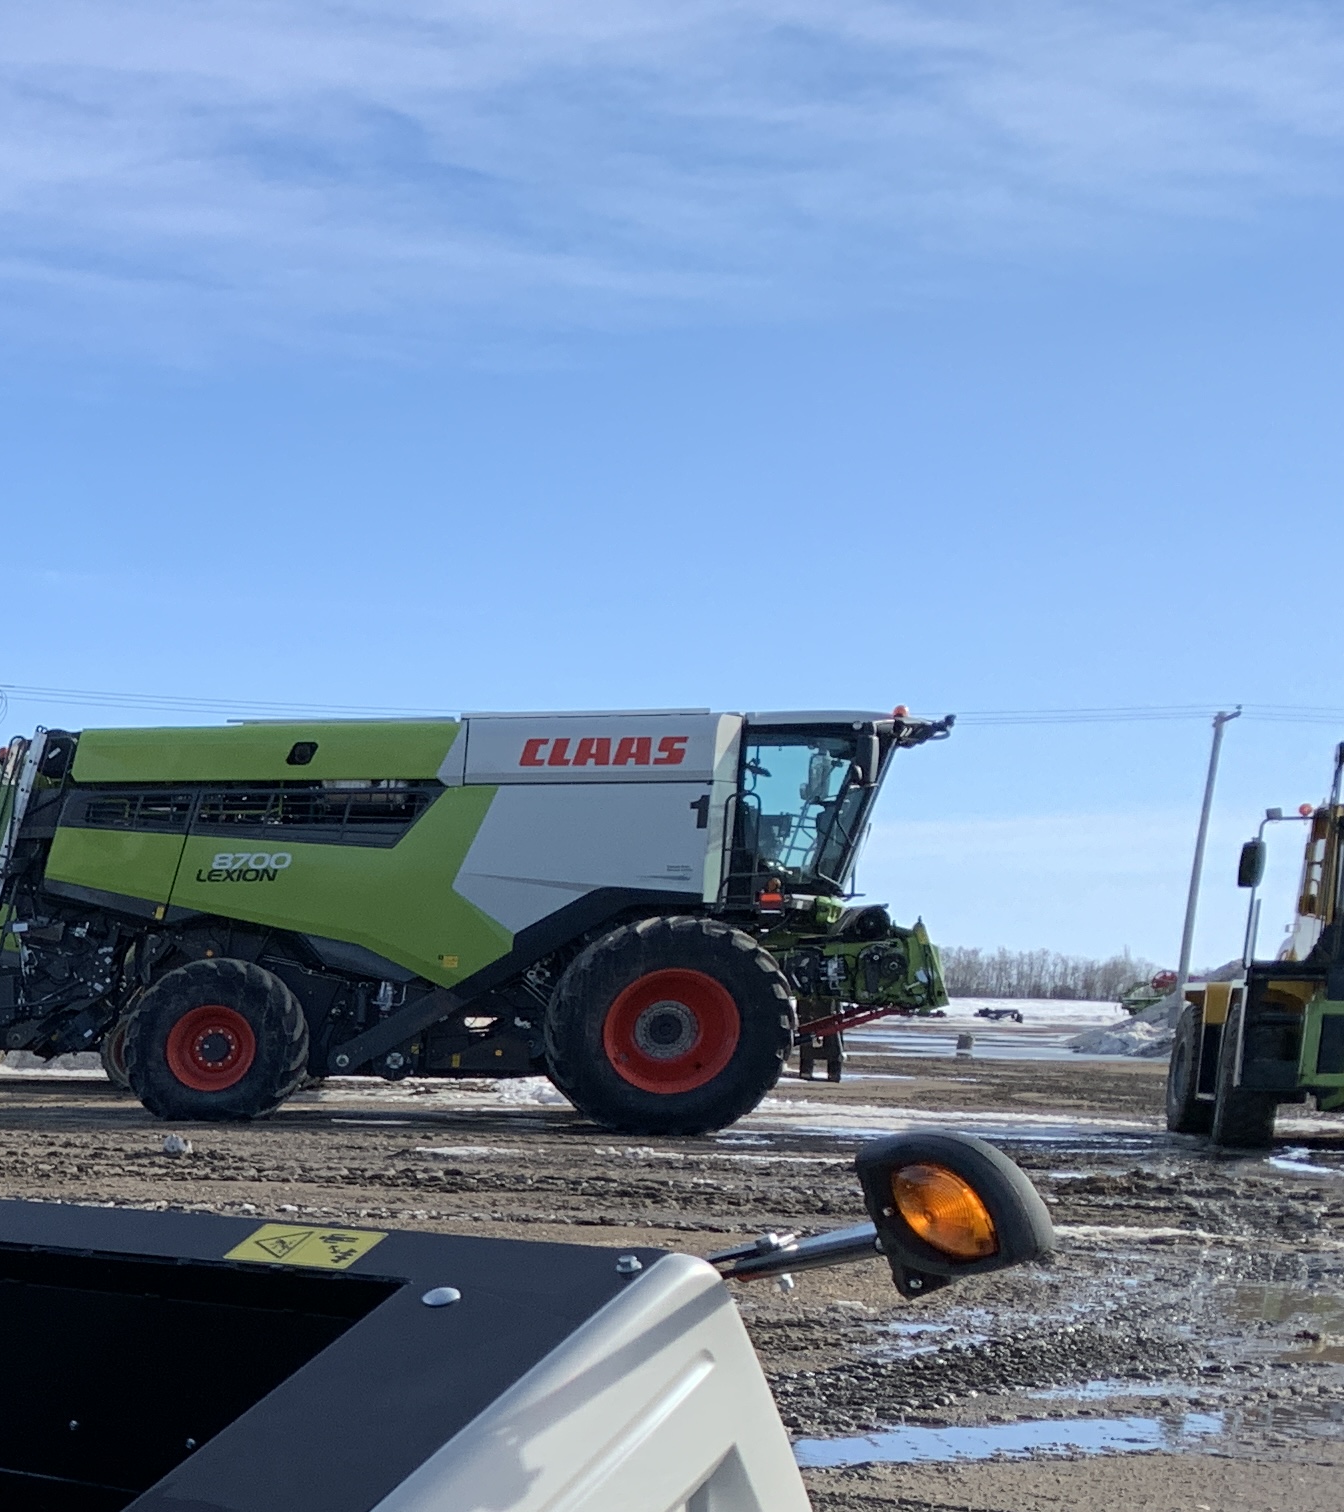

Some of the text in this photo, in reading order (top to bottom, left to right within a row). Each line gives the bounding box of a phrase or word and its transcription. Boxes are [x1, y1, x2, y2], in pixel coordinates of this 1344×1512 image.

[518, 736, 690, 767] CLAAS
[690, 794, 711, 829] 1
[212, 852, 292, 870] 8700
[195, 868, 278, 883] LEXION
